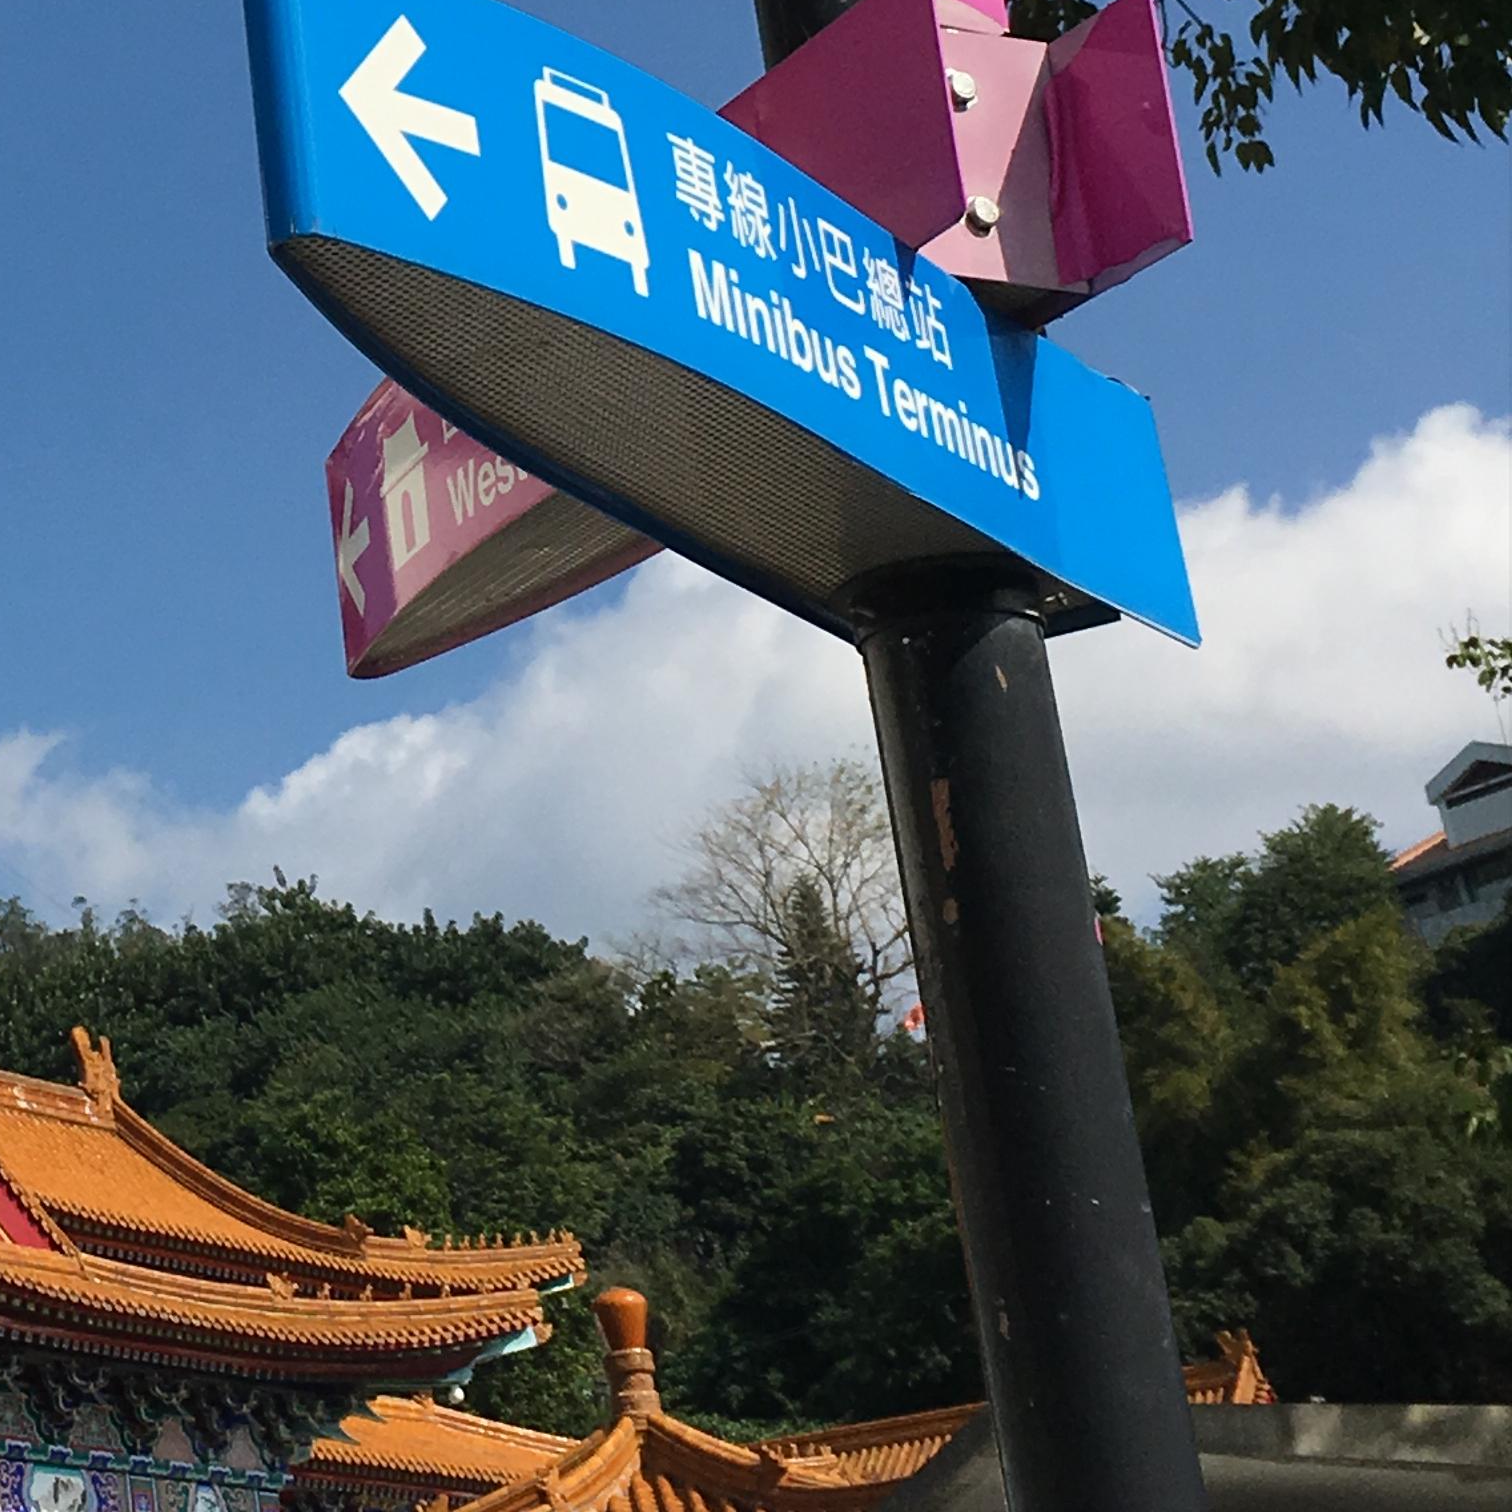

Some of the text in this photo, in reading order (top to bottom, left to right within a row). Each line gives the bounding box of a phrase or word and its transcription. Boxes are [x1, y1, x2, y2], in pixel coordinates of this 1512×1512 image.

[666, 132, 954, 370] 專線小巴總站
[687, 248, 1041, 502] Minibus Terminus
